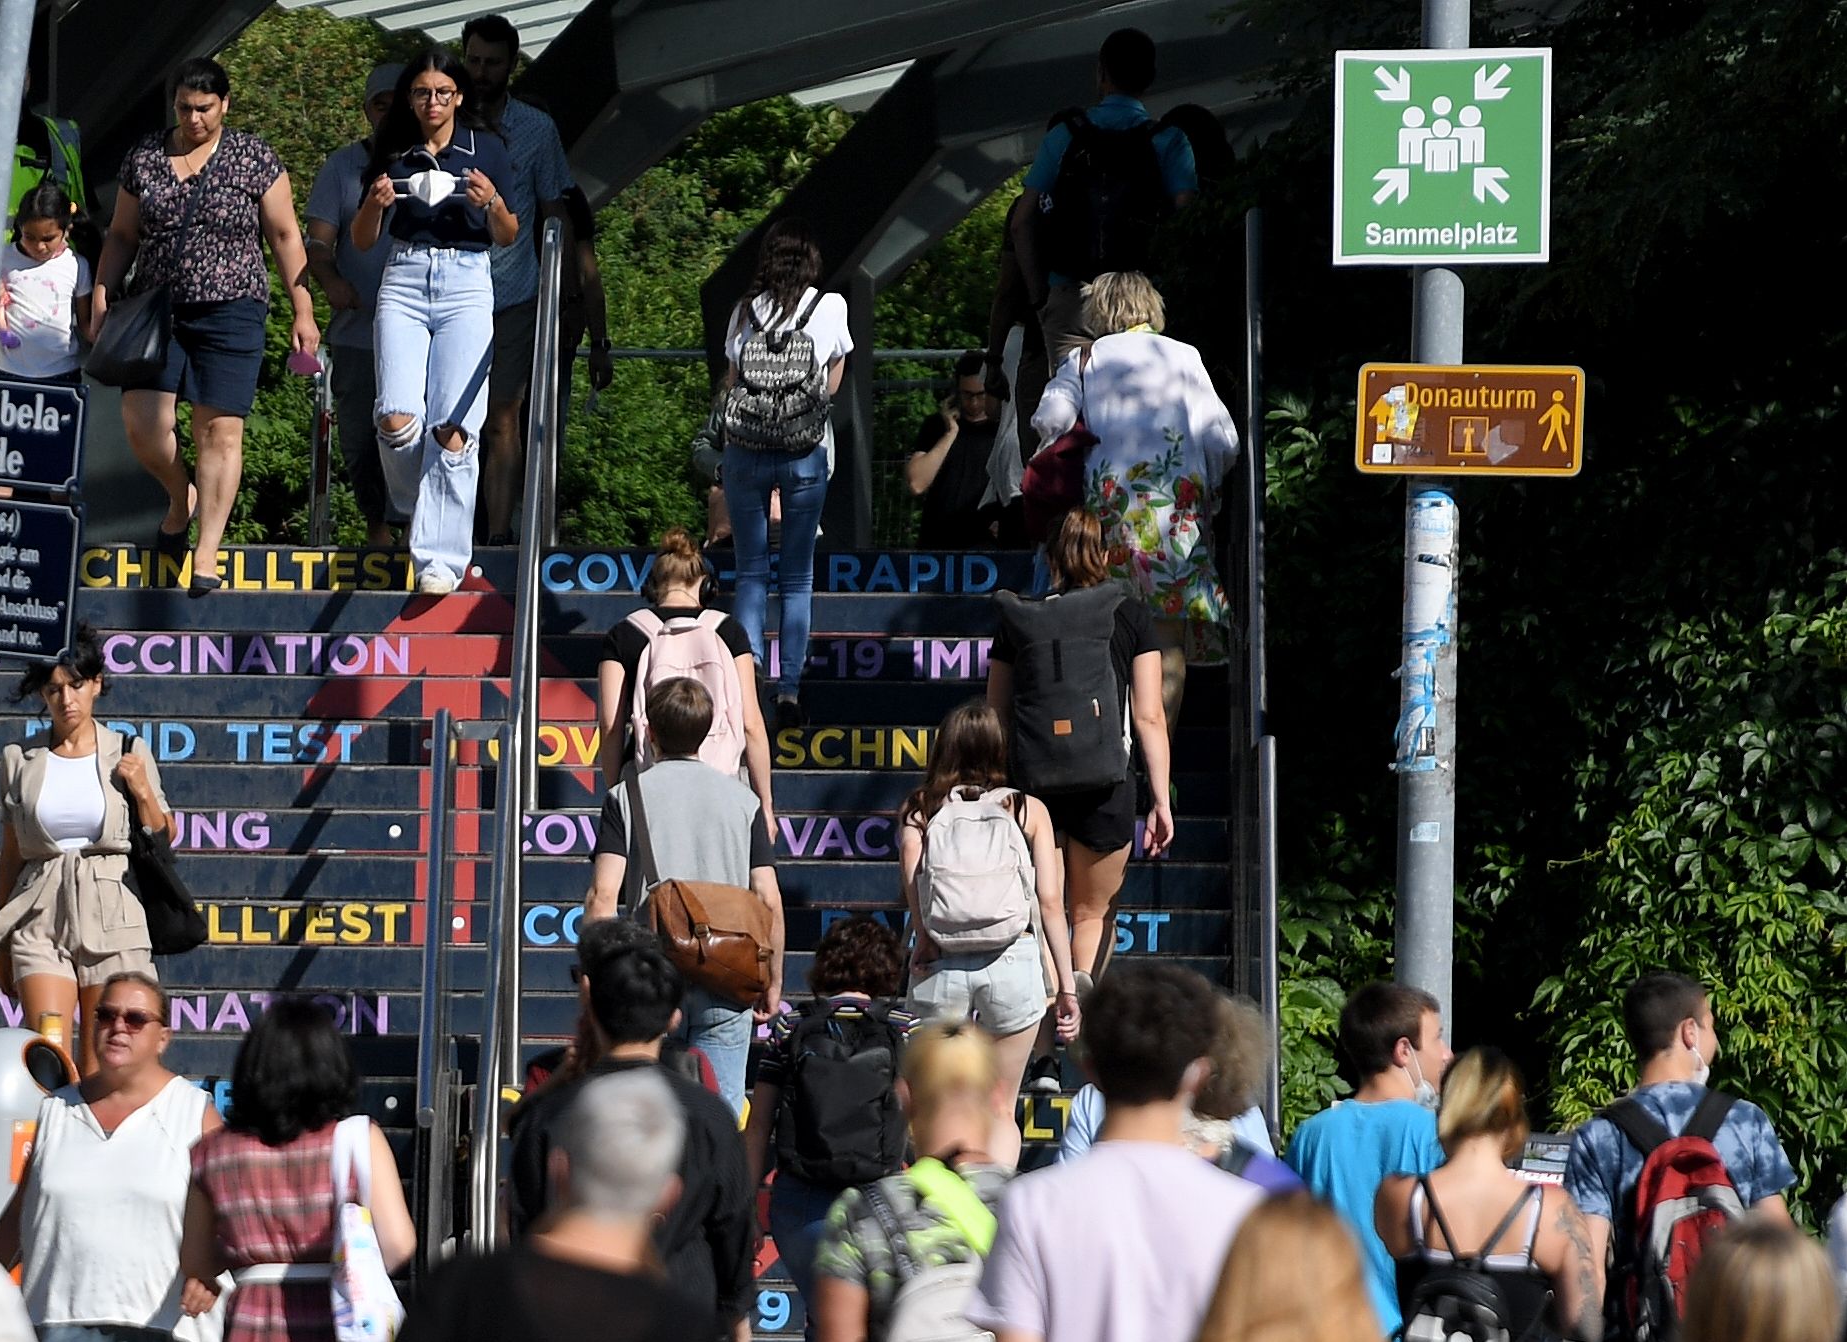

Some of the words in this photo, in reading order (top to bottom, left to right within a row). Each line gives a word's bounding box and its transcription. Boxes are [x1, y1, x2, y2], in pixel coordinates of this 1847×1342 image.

[1365, 222, 1518, 249] Sammelplatz
[1404, 382, 1536, 409] Donauturm
[19, 546, 40, 564] am
[12, 569, 31, 590] die
[829, 554, 998, 593] RAPID
[19, 629, 43, 647] vor.
[226, 722, 362, 763] TEST
